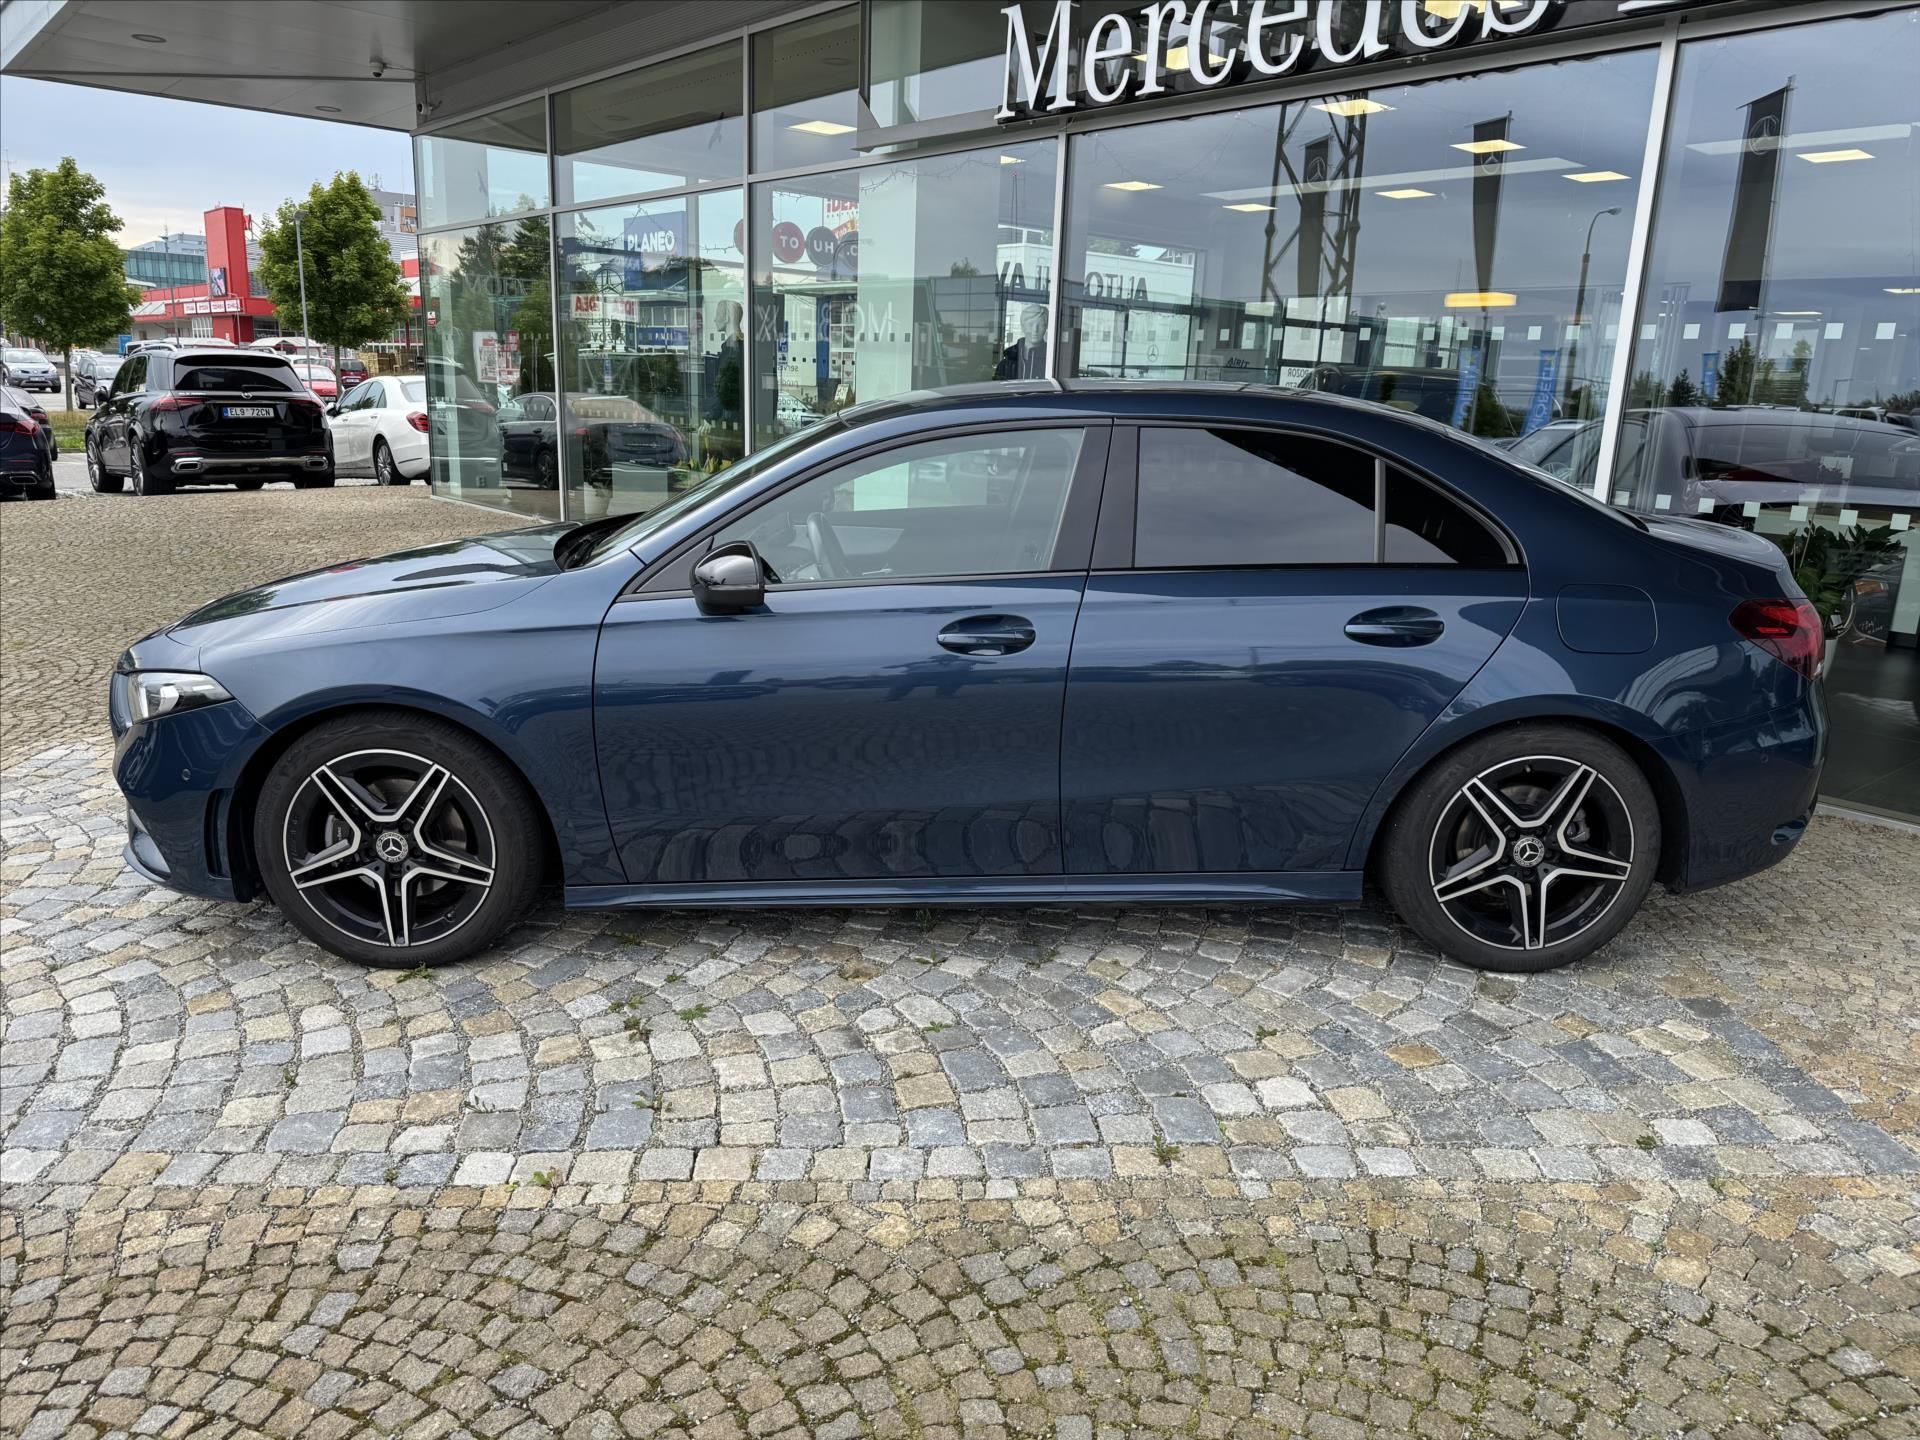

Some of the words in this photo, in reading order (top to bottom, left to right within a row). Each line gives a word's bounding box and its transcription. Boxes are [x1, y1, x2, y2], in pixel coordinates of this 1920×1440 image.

[627, 230, 675, 253] PLANEO
[229, 407, 246, 416] EL9
[250, 408, 271, 417] 72CN
